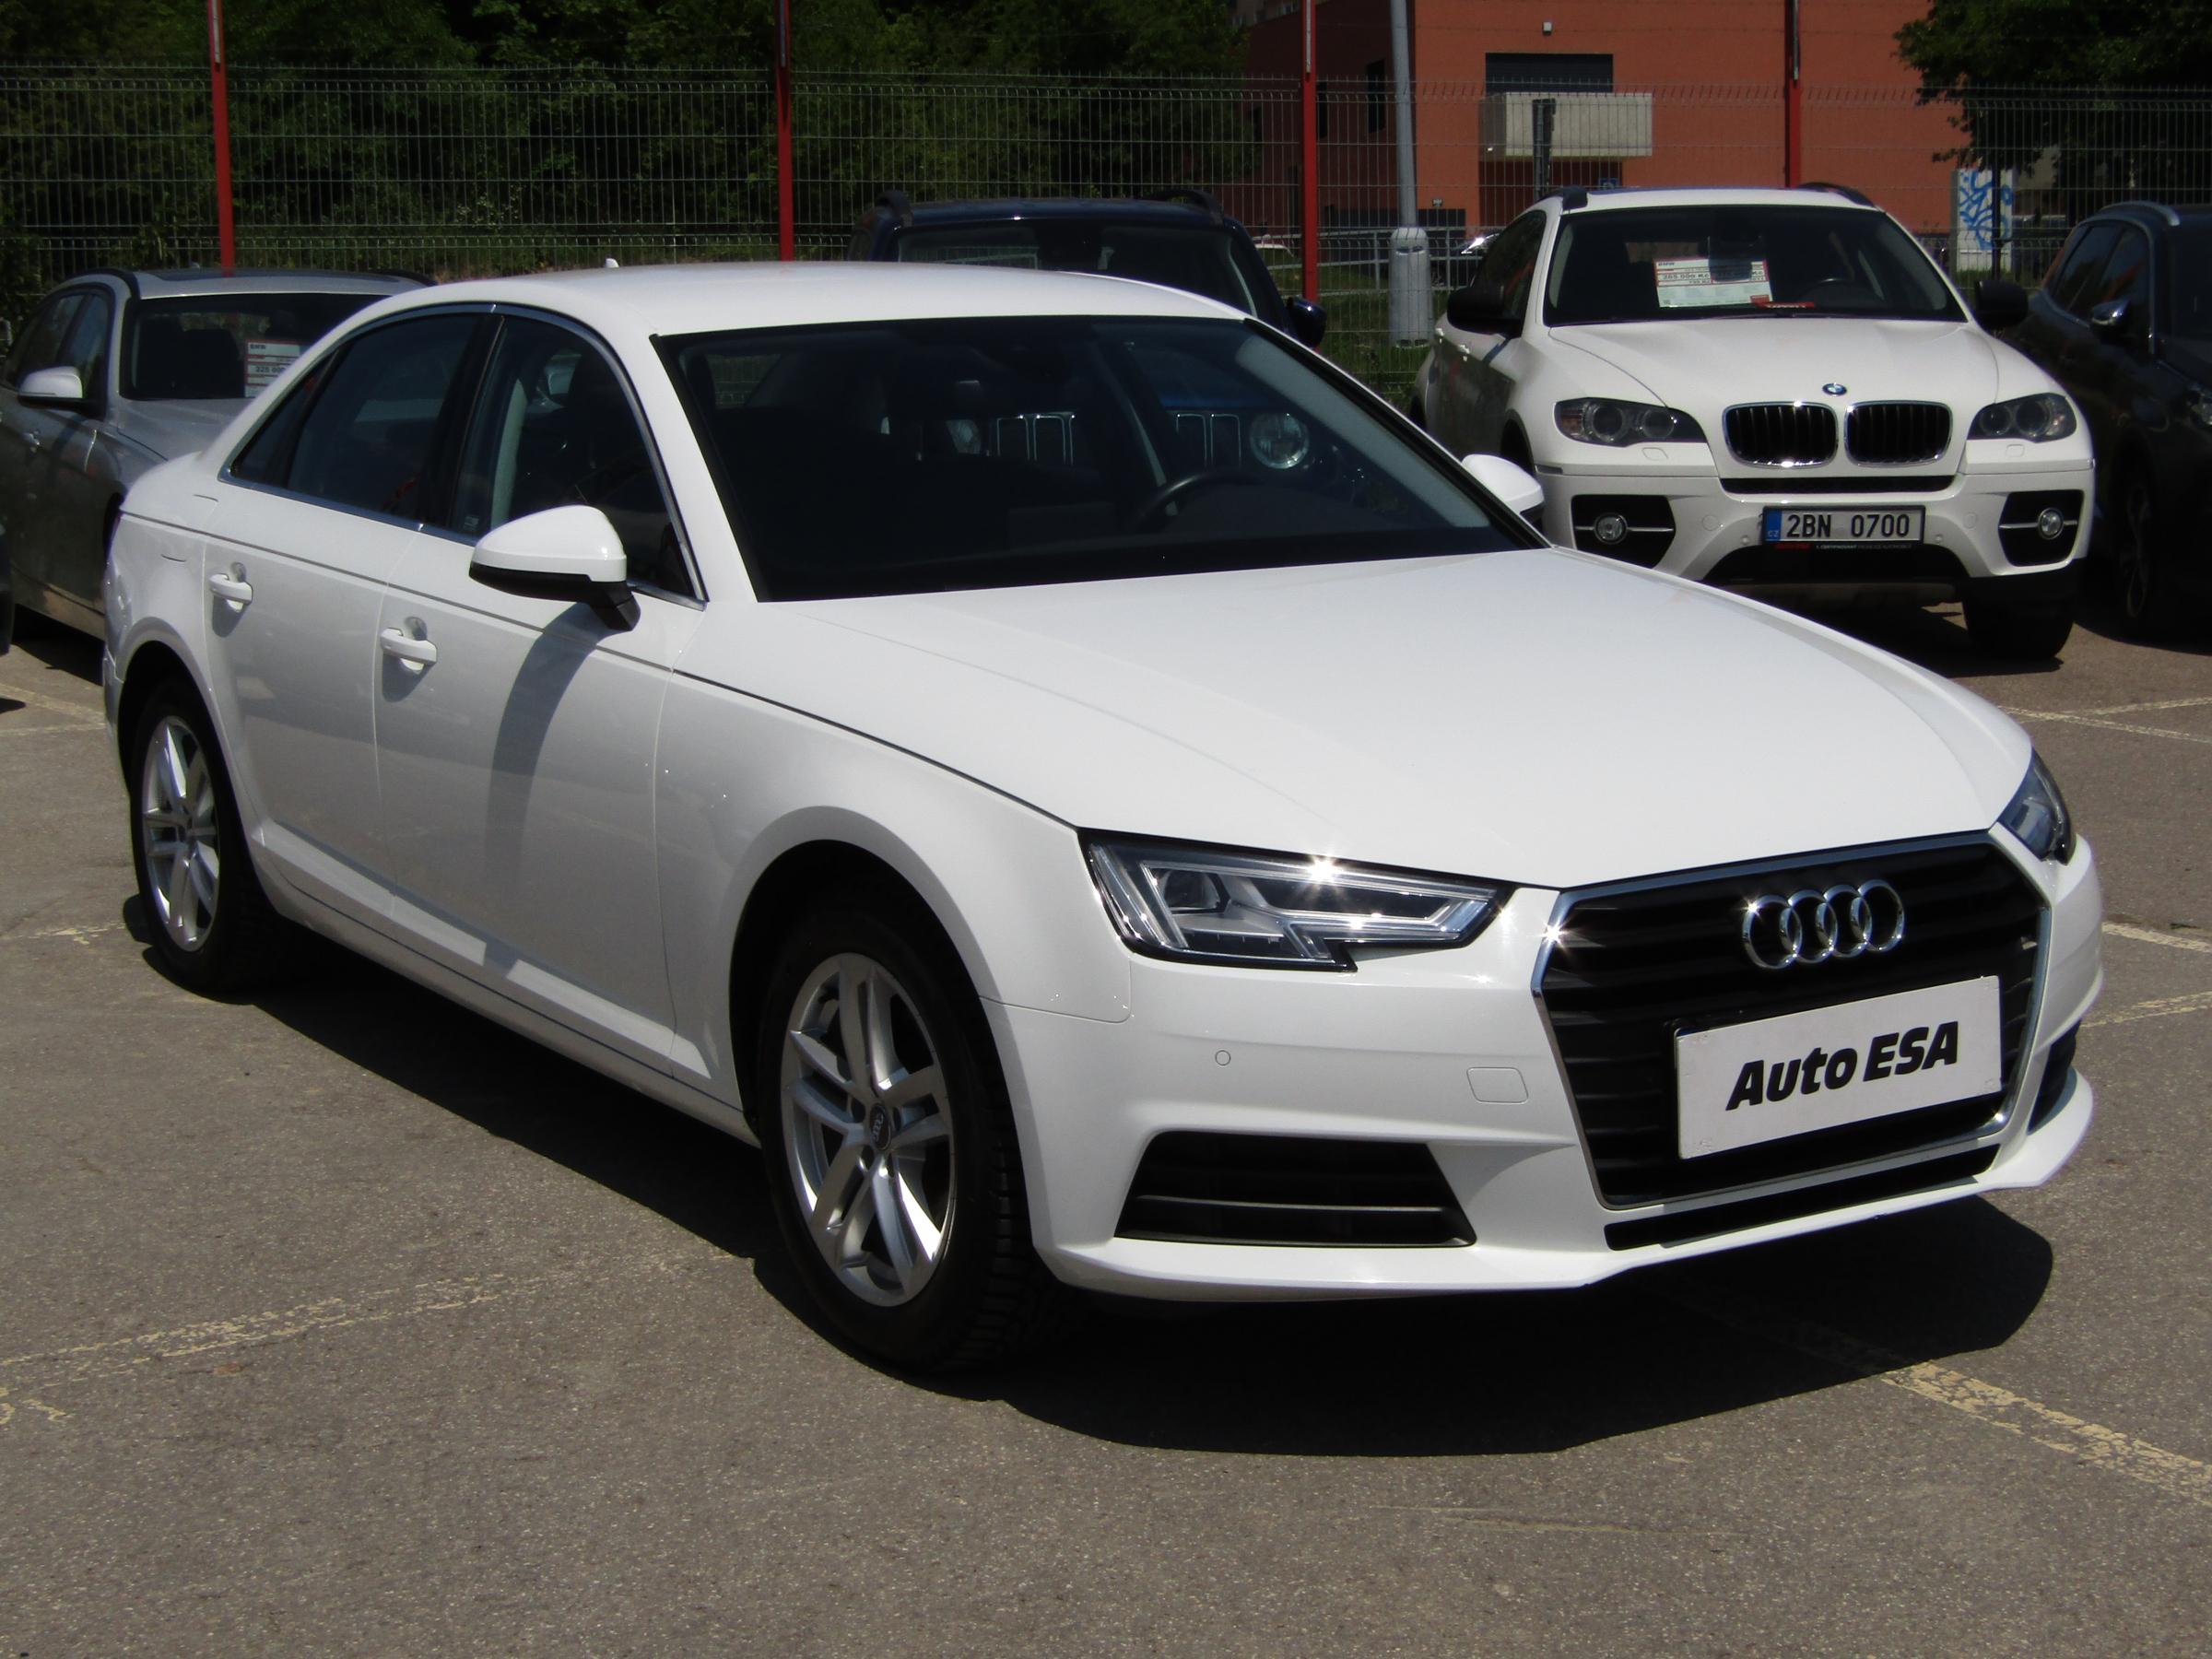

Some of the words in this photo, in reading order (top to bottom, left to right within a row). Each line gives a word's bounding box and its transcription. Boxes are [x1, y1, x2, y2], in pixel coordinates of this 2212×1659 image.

[1786, 513, 1832, 538] 2BN
[1851, 513, 1910, 538] 0700
[1725, 1047, 1858, 1112] Auto
[1863, 1020, 1959, 1082] ESA
